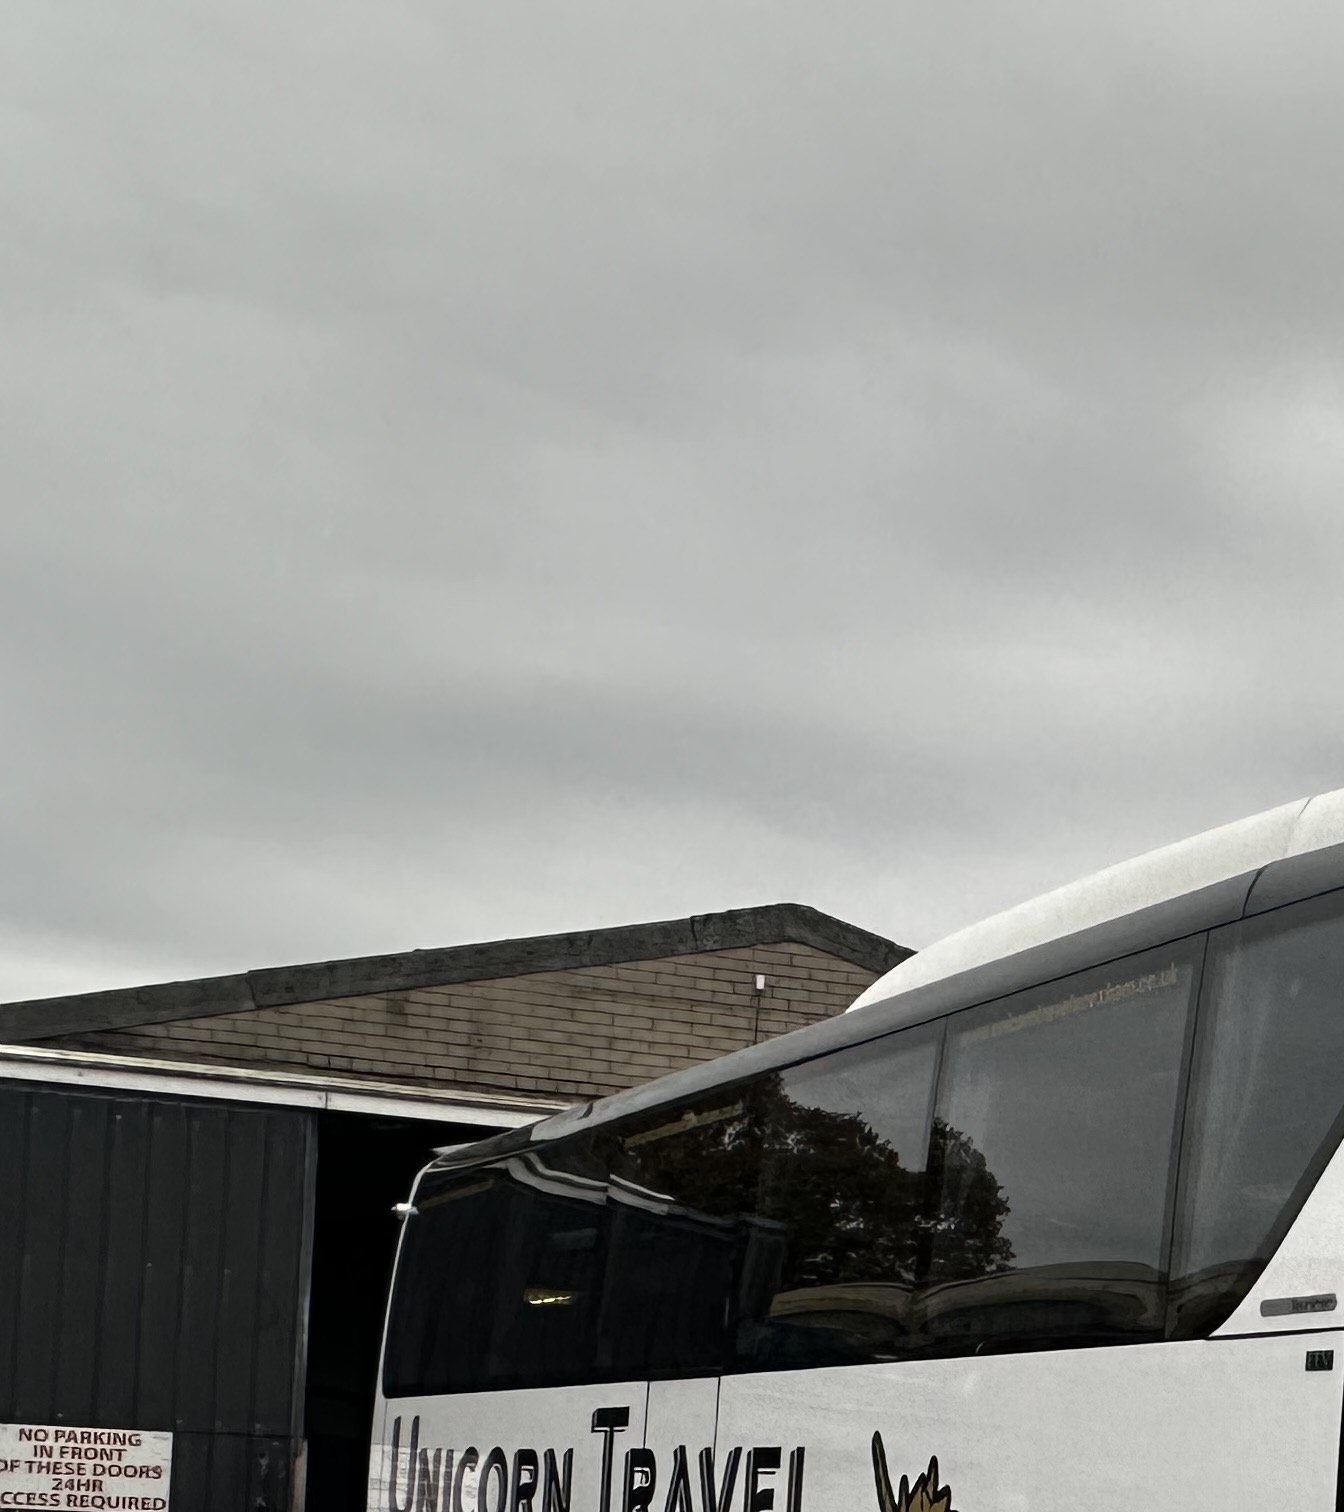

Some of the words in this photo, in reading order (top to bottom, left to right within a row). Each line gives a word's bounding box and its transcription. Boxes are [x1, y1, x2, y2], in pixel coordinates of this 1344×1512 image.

[18, 1428, 49, 1442] NO
[54, 1430, 142, 1447] PARKING
[33, 1445, 53, 1459] IN
[59, 1447, 127, 1462] FRONT
[25, 1461, 86, 1476] THESE
[92, 1464, 163, 1479] DOORS
[51, 1478, 104, 1492] 24HR
[0, 1491, 60, 1506] CCESS
[66, 1494, 167, 1511] REQUIRED
